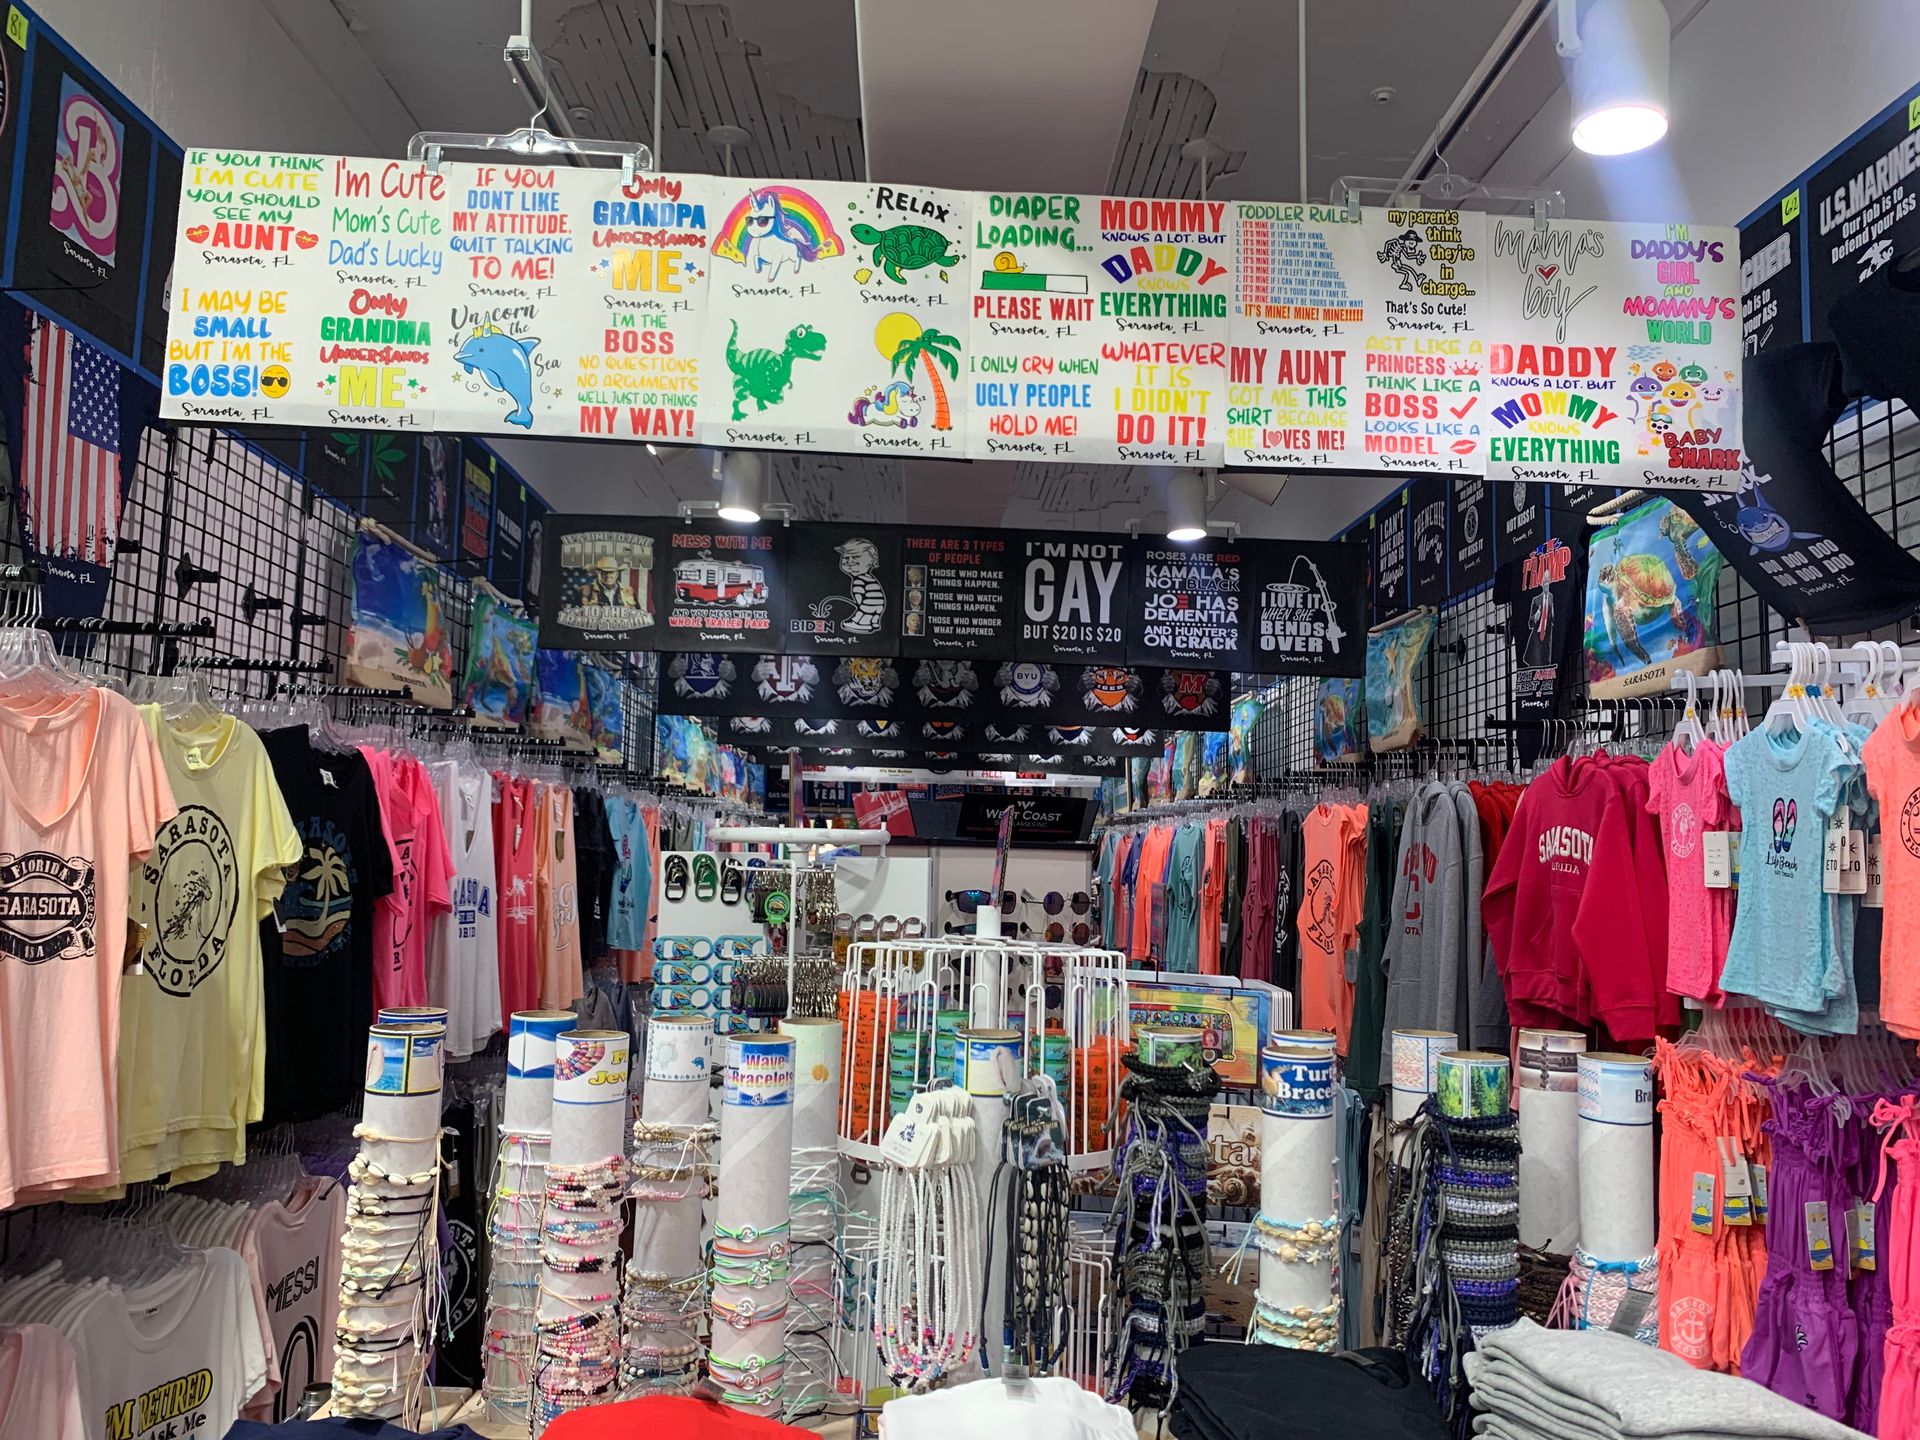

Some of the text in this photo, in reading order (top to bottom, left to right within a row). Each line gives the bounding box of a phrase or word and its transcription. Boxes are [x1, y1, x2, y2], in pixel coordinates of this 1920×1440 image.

[190, 152, 324, 171] IF YOU THINK
[193, 166, 319, 191] I'M CUTE
[187, 189, 320, 209] YOU SHOULD
[876, 186, 950, 223] RELAX
[213, 206, 293, 223] SEE MY
[593, 200, 706, 230] GRANDPA
[989, 195, 1081, 223] DIAPER
[1842, 186, 1903, 239] Our job is to
[1389, 210, 1458, 227] my parents
[212, 222, 294, 251] AUNT
[1426, 227, 1461, 243] think
[1832, 193, 1916, 264] Defend your ASS
[976, 224, 1094, 252] LOADING...
[1430, 244, 1475, 263] they're
[1630, 239, 1724, 264] DADDY'S
[612, 249, 682, 293] ME
[1440, 264, 1454, 280] in
[1656, 261, 1700, 285] GIRL
[732, 283, 821, 300] Sarasota, FL
[1421, 281, 1476, 298] charge...
[1663, 283, 1694, 298] AND
[974, 296, 1094, 322] PLEASE WAIT
[1245, 304, 1261, 317] IT'S
[1265, 305, 1290, 319] MINE!
[1294, 307, 1319, 320] MINE!
[1385, 300, 1467, 316] That's So Cute!
[1622, 295, 1736, 320] MOMMY'S
[1646, 319, 1712, 345] WORLD
[1663, 428, 1723, 447] BABY
[1667, 447, 1741, 471] SHARK
[672, 533, 772, 550] MESS WITH ME
[906, 537, 1004, 552] THERE ARE 3 TYPES
[1026, 541, 1123, 559] I'M NOT
[928, 552, 981, 565] OF PEOPLE
[1146, 550, 1240, 563] ROSES ARE RED
[1781, 550, 1808, 569] DOO
[1808, 539, 1839, 559] DOO
[929, 568, 1004, 579] THOSE WHO MAKE
[1145, 564, 1240, 580] KAMALA'S
[1797, 565, 1823, 582] DOO
[1823, 553, 1855, 574] DOO
[79, 574, 95, 585] FL
[932, 578, 1000, 589] THINGS HAPPEN.
[1145, 577, 1240, 592] NOT BLACK
[1837, 573, 1855, 587] FL
[1024, 558, 1123, 625] GAY
[1145, 593, 1239, 611] JOE HAS
[1261, 592, 1321, 609] I LOVE IT
[672, 609, 689, 617] AND
[1144, 608, 1239, 624] DEMENTIA
[1261, 607, 1316, 621] WHEN SHE
[668, 616, 703, 628] WHOLE
[705, 617, 743, 628] TRAILER
[744, 618, 770, 629] PARK
[790, 619, 834, 633] BIDEN
[1260, 621, 1325, 637] BENDS
[1024, 624, 1121, 643] BUT $20 IS $20
[1144, 625, 1238, 638] AND HUNTER'S
[1143, 634, 1238, 650] ON CRACK
[1260, 635, 1324, 653] OVER
[1016, 672, 1038, 680] BYU
[1623, 668, 1665, 687] SARASOTA
[813, 787, 845, 800] YEAH
[986, 809, 1020, 819] WET
[144, 814, 234, 886] SARASOTA
[11, 859, 68, 881] FLORIDA
[746, 1054, 785, 1069] Wave
[731, 1071, 794, 1088] Bracelets
[266, 1255, 320, 1313] MESSI
[137, 1368, 214, 1435] RETIRED
[181, 1411, 207, 1435] Me
